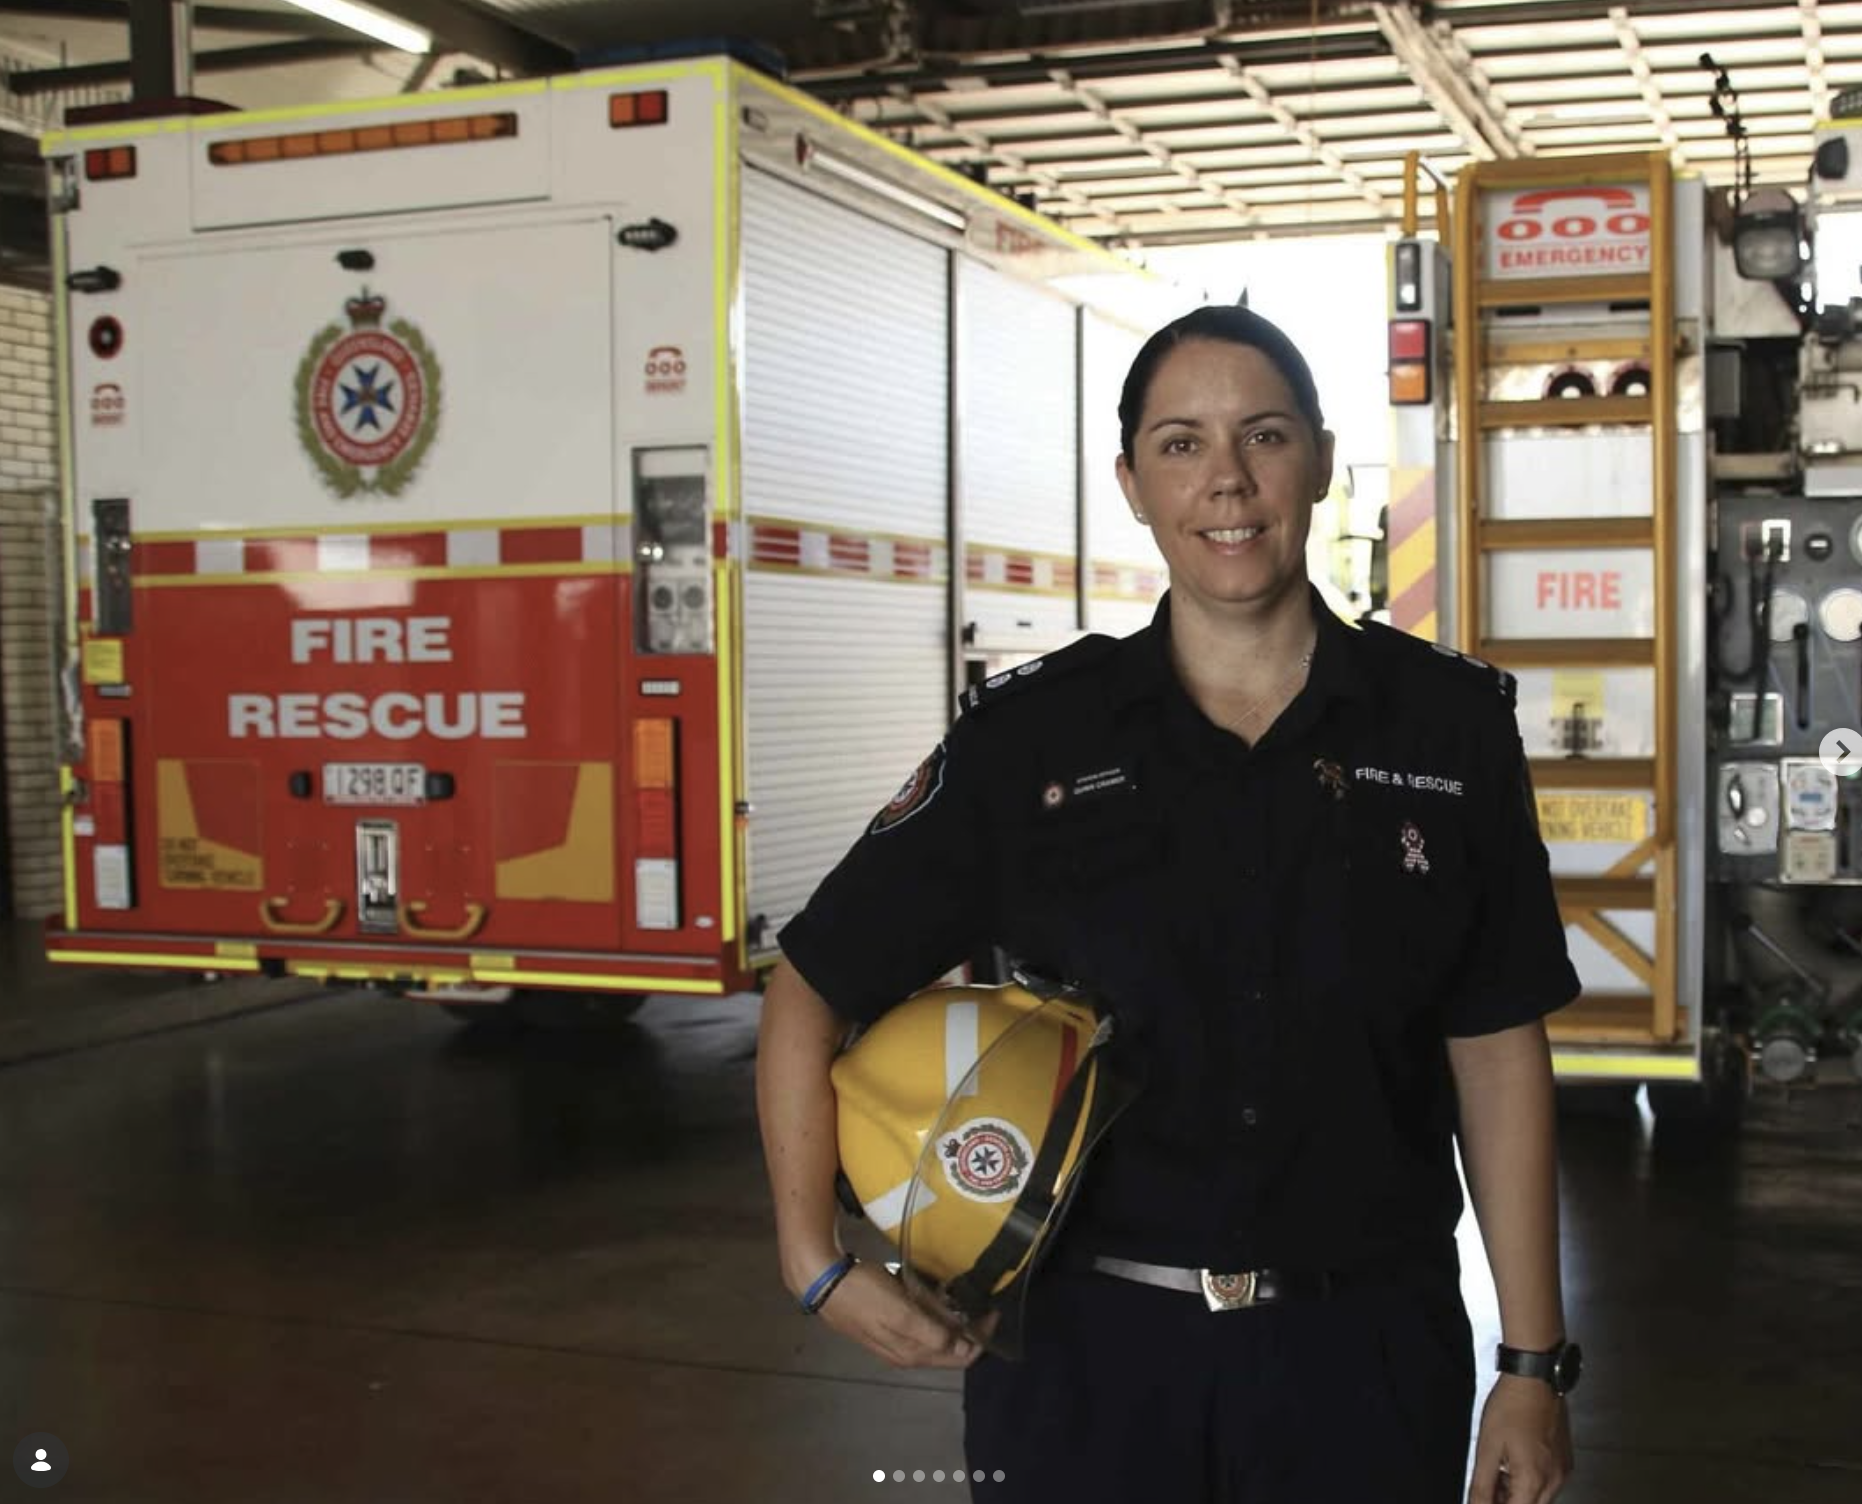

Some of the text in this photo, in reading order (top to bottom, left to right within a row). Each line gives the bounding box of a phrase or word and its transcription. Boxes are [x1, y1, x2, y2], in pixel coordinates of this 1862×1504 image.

[1500, 244, 1648, 269] EMERGENCY
[1537, 570, 1622, 610] FIRE
[291, 616, 453, 664] FIRE
[228, 691, 528, 740] RESCUE
[1355, 767, 1463, 796] FIRE & RESCUE
[1569, 800, 1632, 818] OVERTAKE
[1582, 821, 1632, 840] VEHICLE
